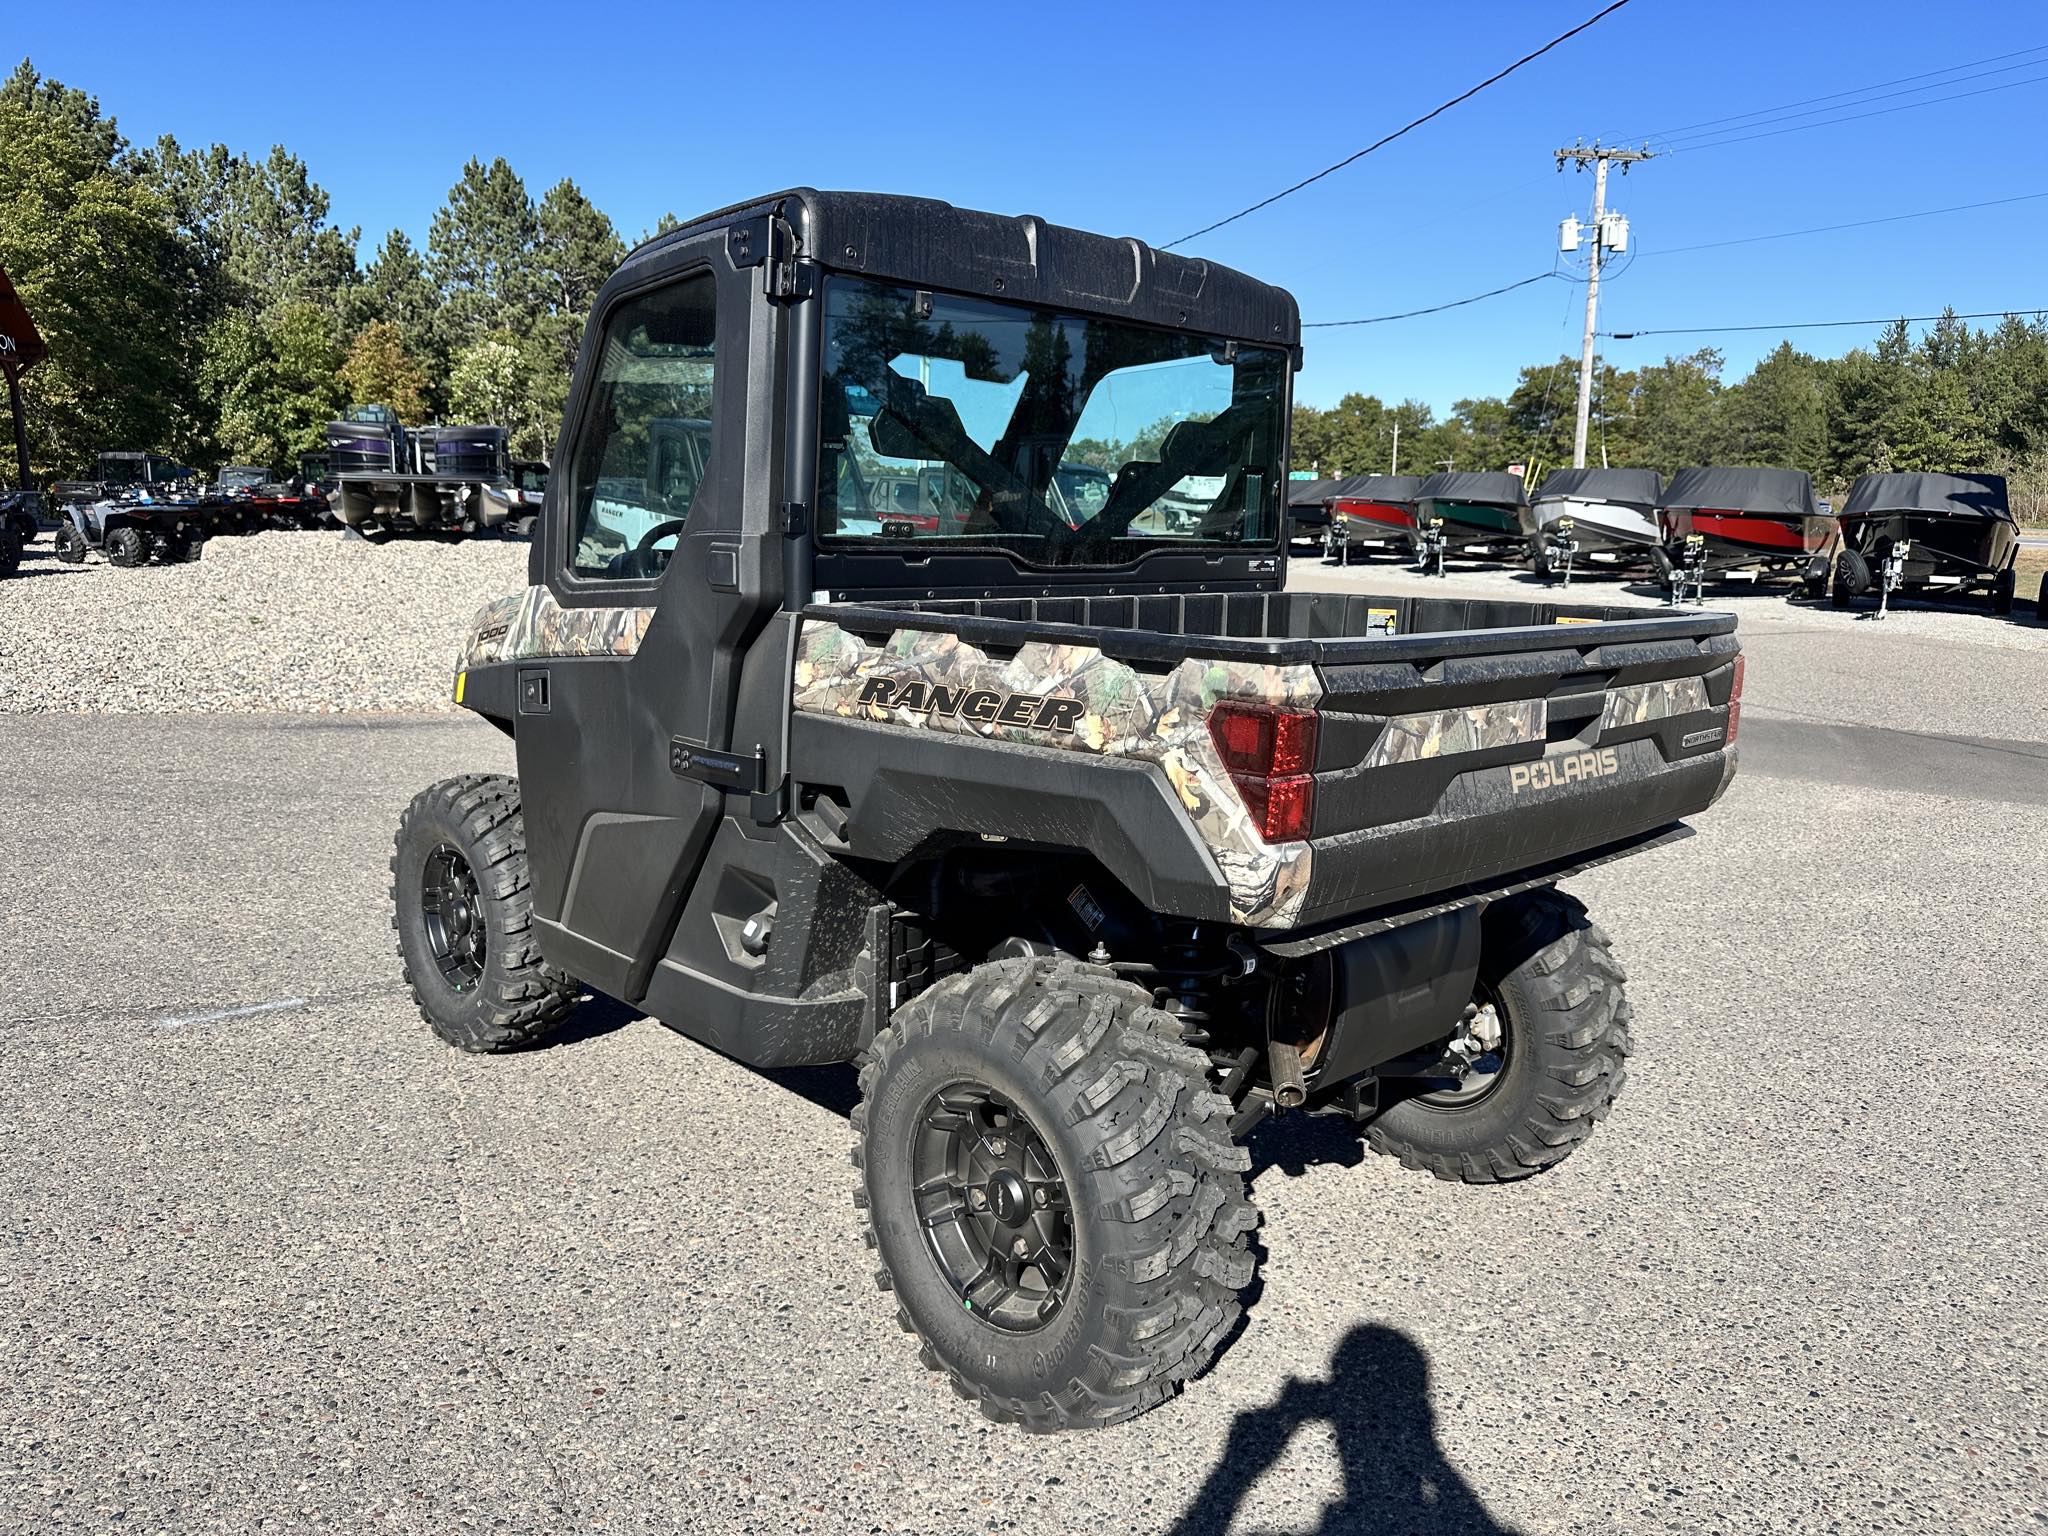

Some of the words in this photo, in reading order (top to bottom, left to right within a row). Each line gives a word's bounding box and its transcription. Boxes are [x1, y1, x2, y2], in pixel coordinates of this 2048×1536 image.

[478, 624, 509, 642] 1000
[857, 676, 1086, 733] RANGER
[1509, 748, 1618, 794] POLARIS
